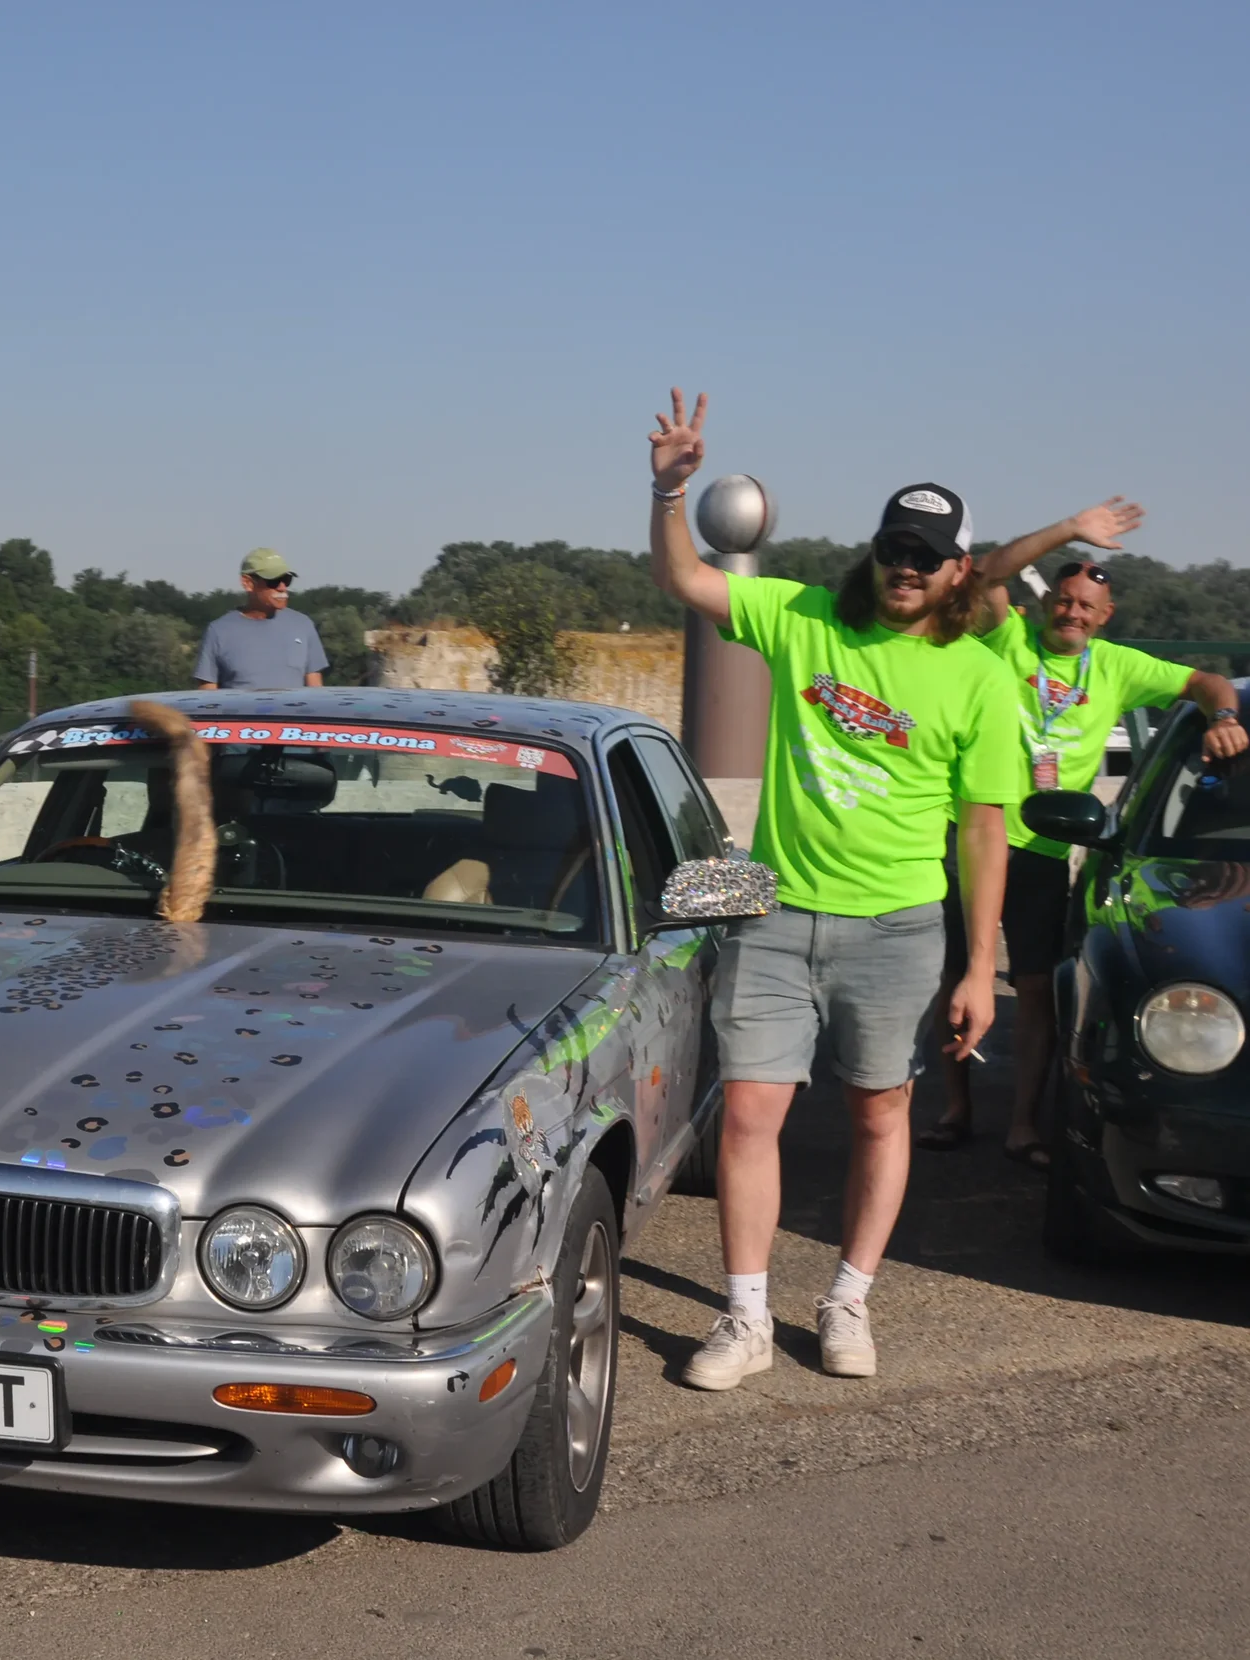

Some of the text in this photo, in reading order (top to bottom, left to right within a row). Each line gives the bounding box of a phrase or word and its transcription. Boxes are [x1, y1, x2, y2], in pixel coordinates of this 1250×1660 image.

[860, 713, 897, 733] Rally
[61, 726, 232, 745] Brookds
[238, 727, 272, 740] to
[277, 727, 437, 750] Barcelona
